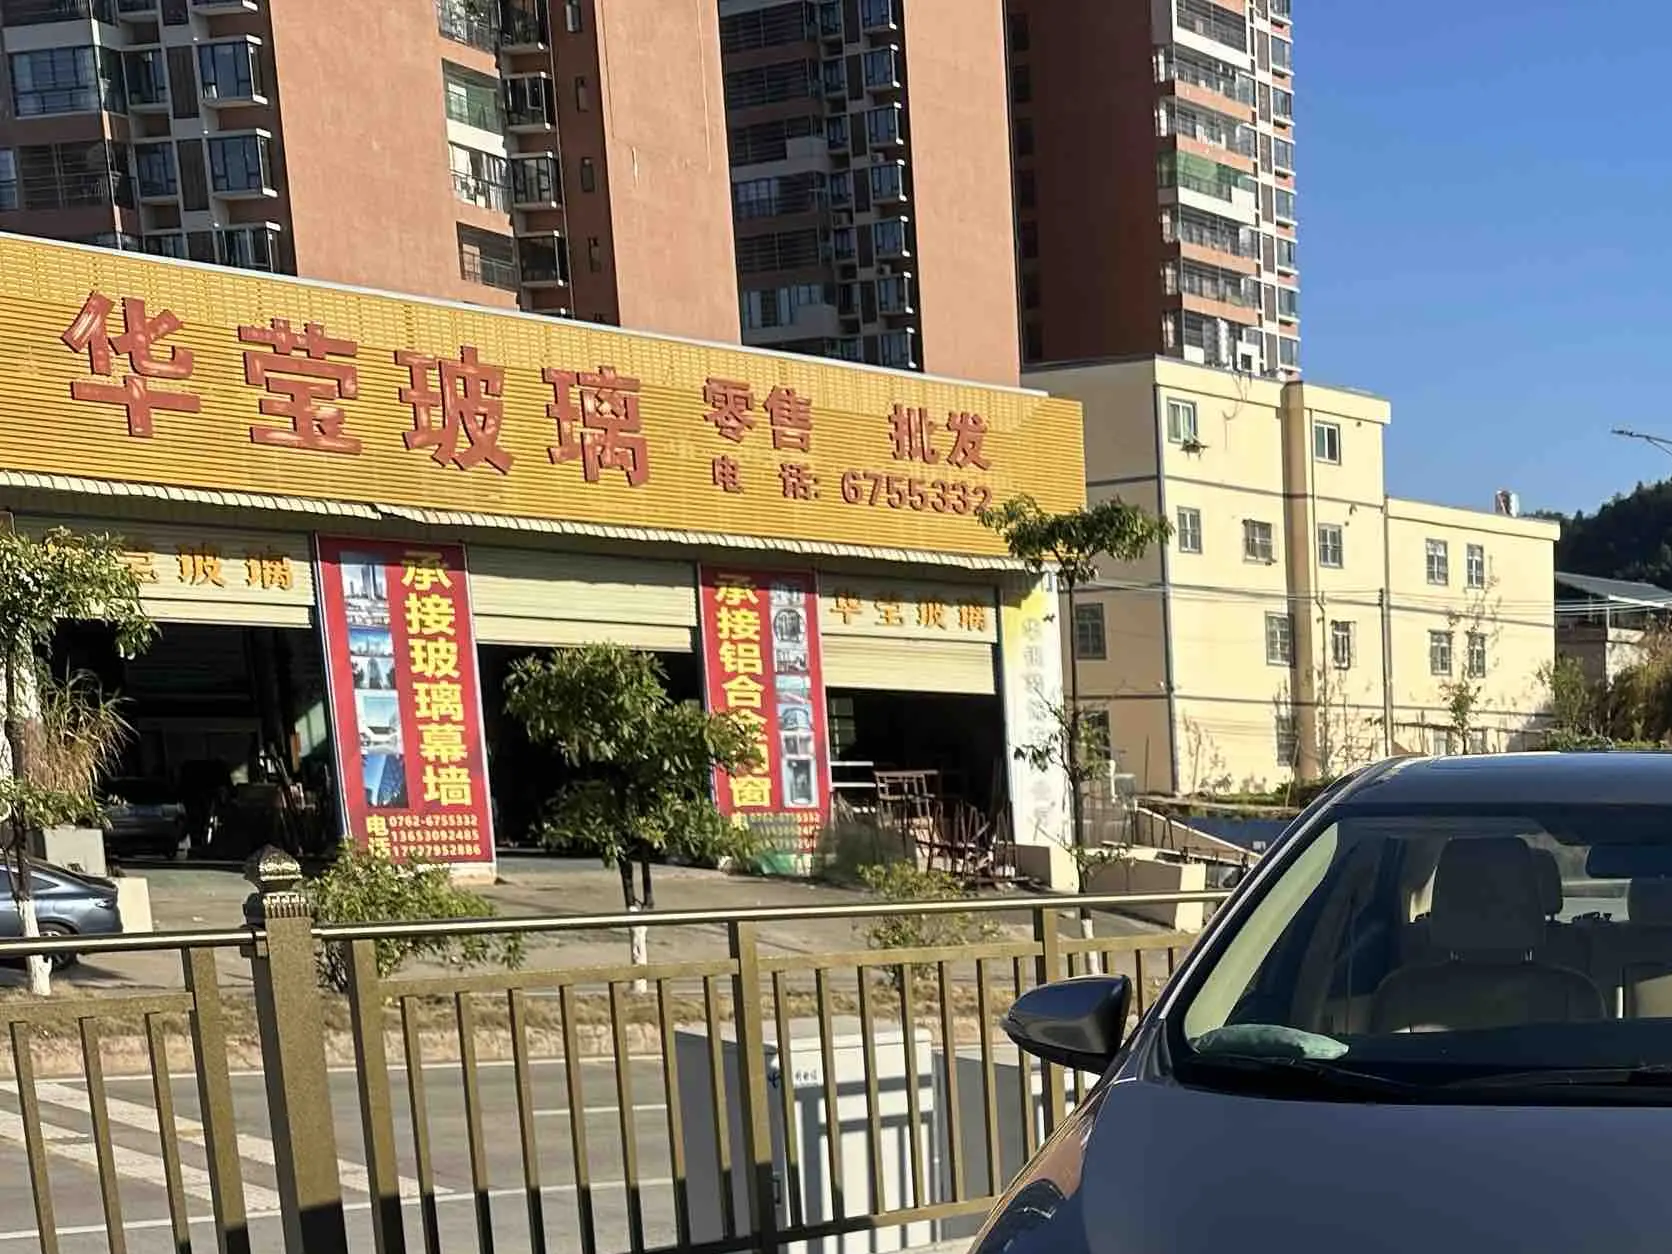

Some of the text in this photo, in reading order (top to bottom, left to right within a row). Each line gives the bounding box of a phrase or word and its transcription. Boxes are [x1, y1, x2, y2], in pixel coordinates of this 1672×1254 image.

[61, 290, 650, 488] 华莹玻璃
[702, 377, 992, 471] 零售 批发
[841, 470, 993, 516] 6755332
[401, 551, 473, 806] 承接玻璃幕墙
